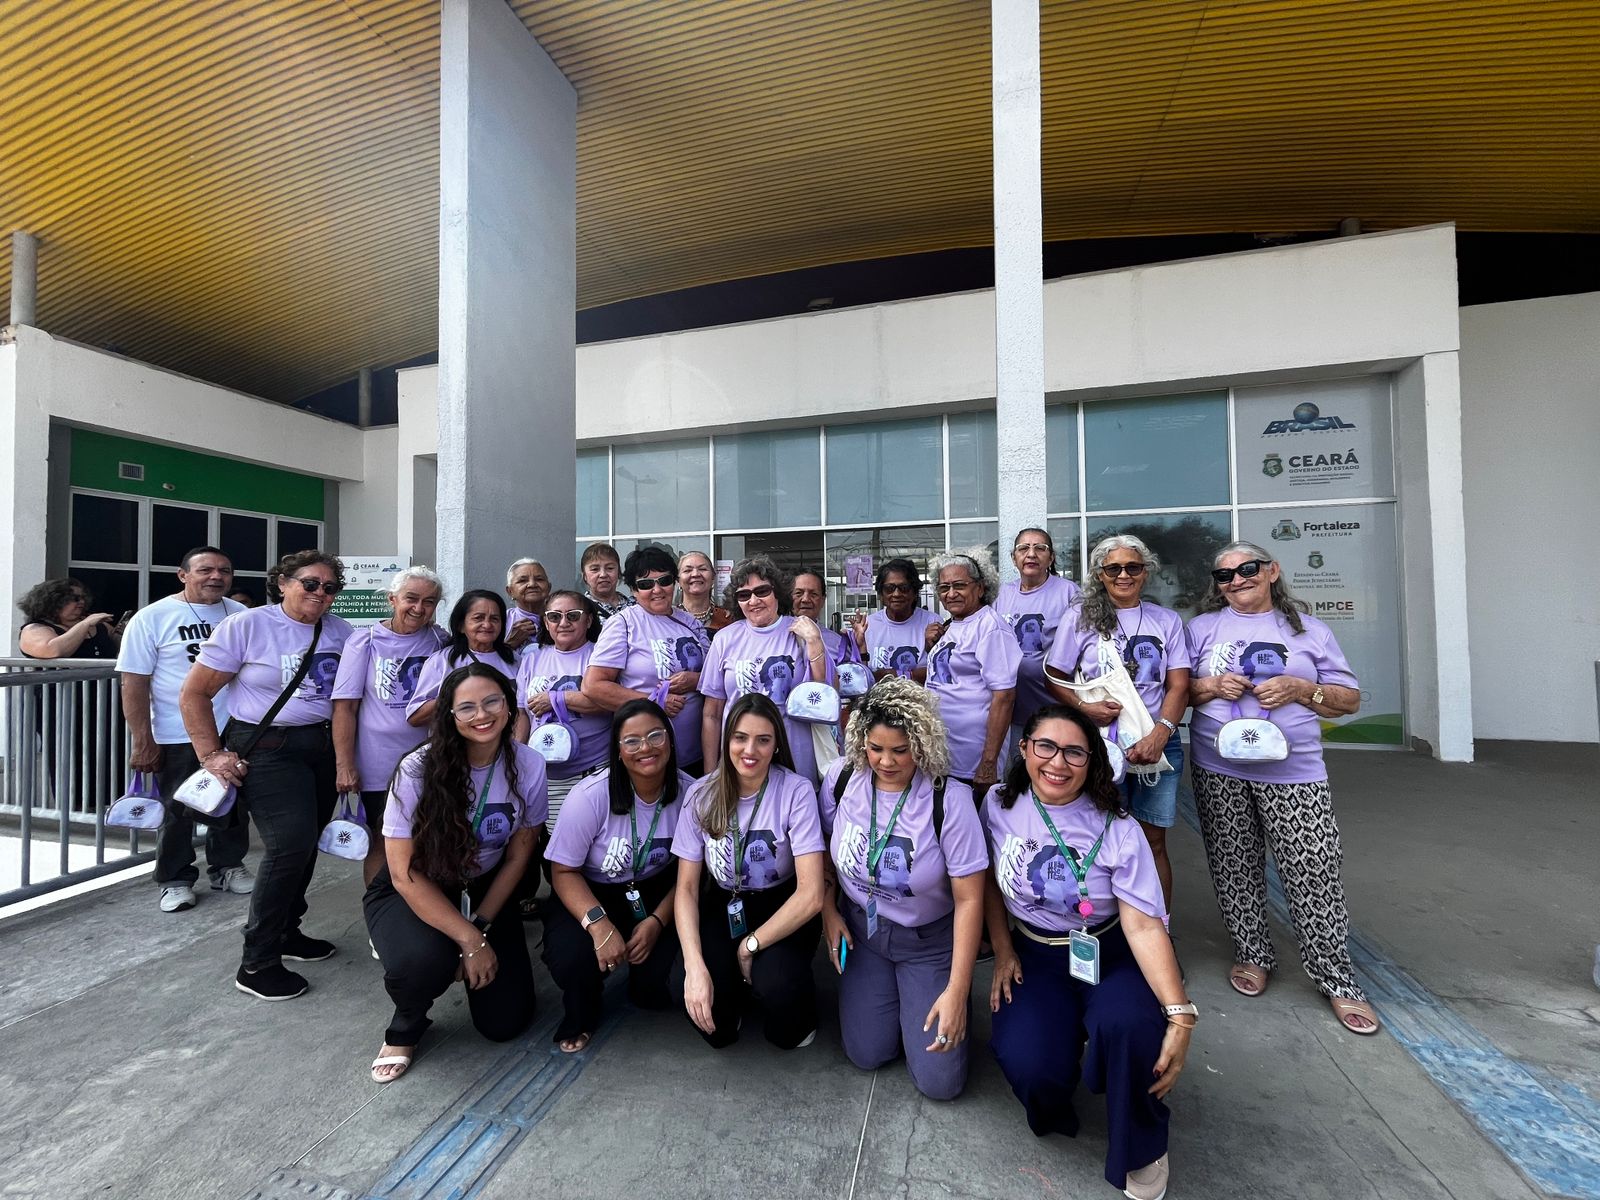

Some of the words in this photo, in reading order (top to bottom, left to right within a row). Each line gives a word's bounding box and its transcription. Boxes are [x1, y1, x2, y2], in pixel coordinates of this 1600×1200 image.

[1288, 448, 1359, 468] CEARÁ
[1303, 521, 1360, 532] Fortaleza
[1315, 601, 1354, 611] MPCE
